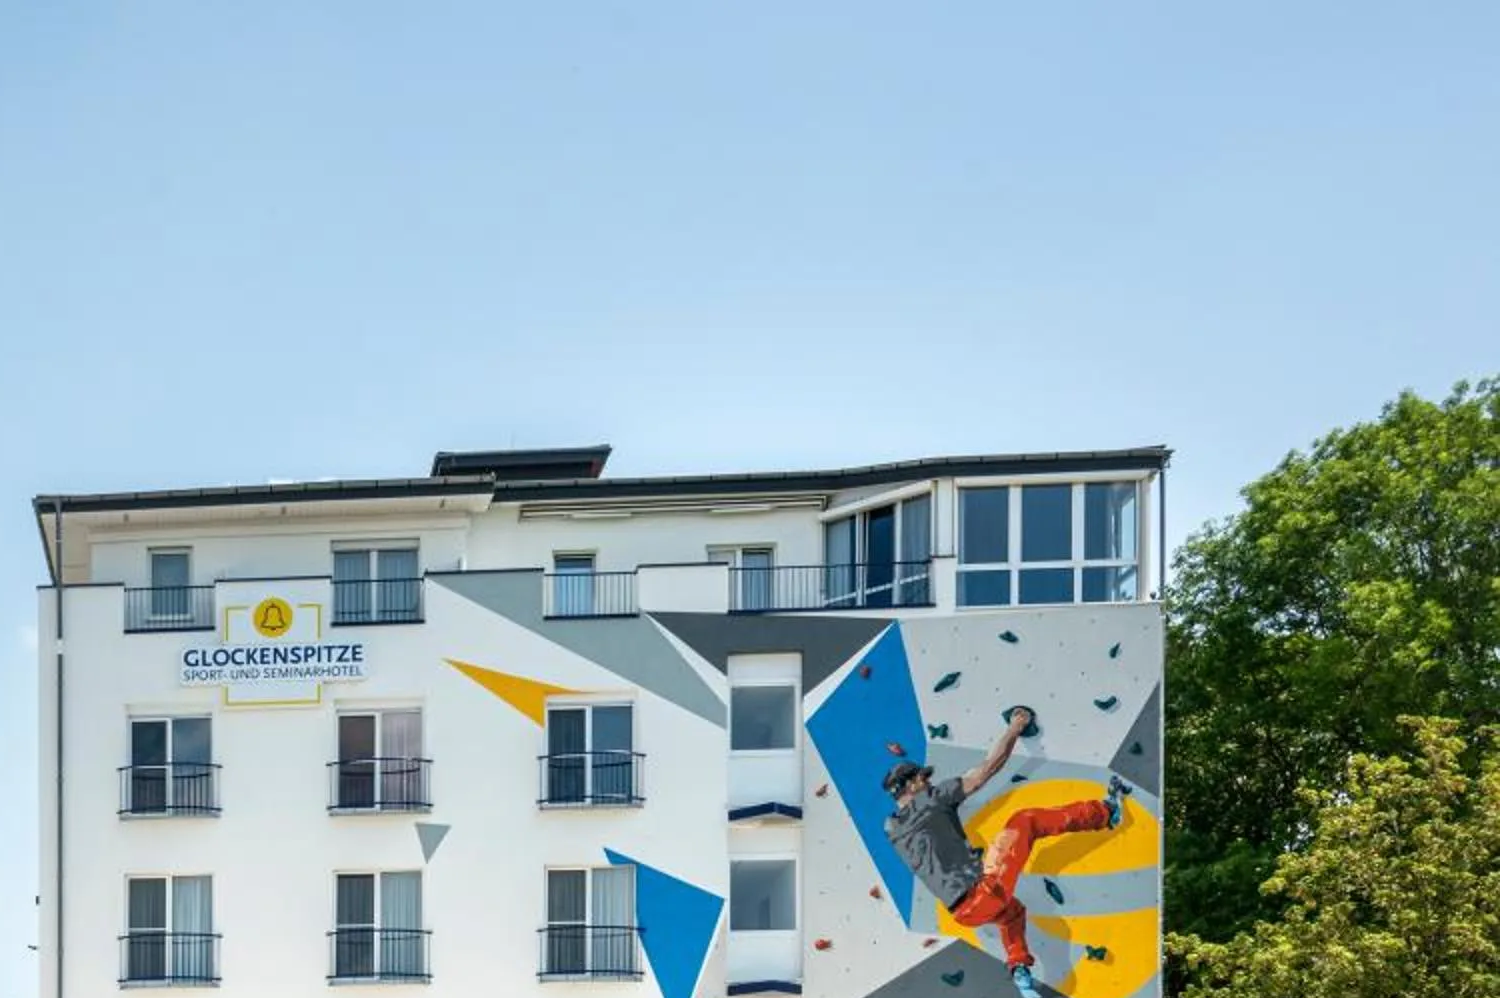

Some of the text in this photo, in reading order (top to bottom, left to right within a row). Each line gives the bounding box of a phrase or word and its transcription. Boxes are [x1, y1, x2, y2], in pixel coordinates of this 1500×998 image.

[183, 644, 364, 667] GLOCKENSPITZE
[183, 665, 363, 681] SPORT- UND SEMINARHOTEL
